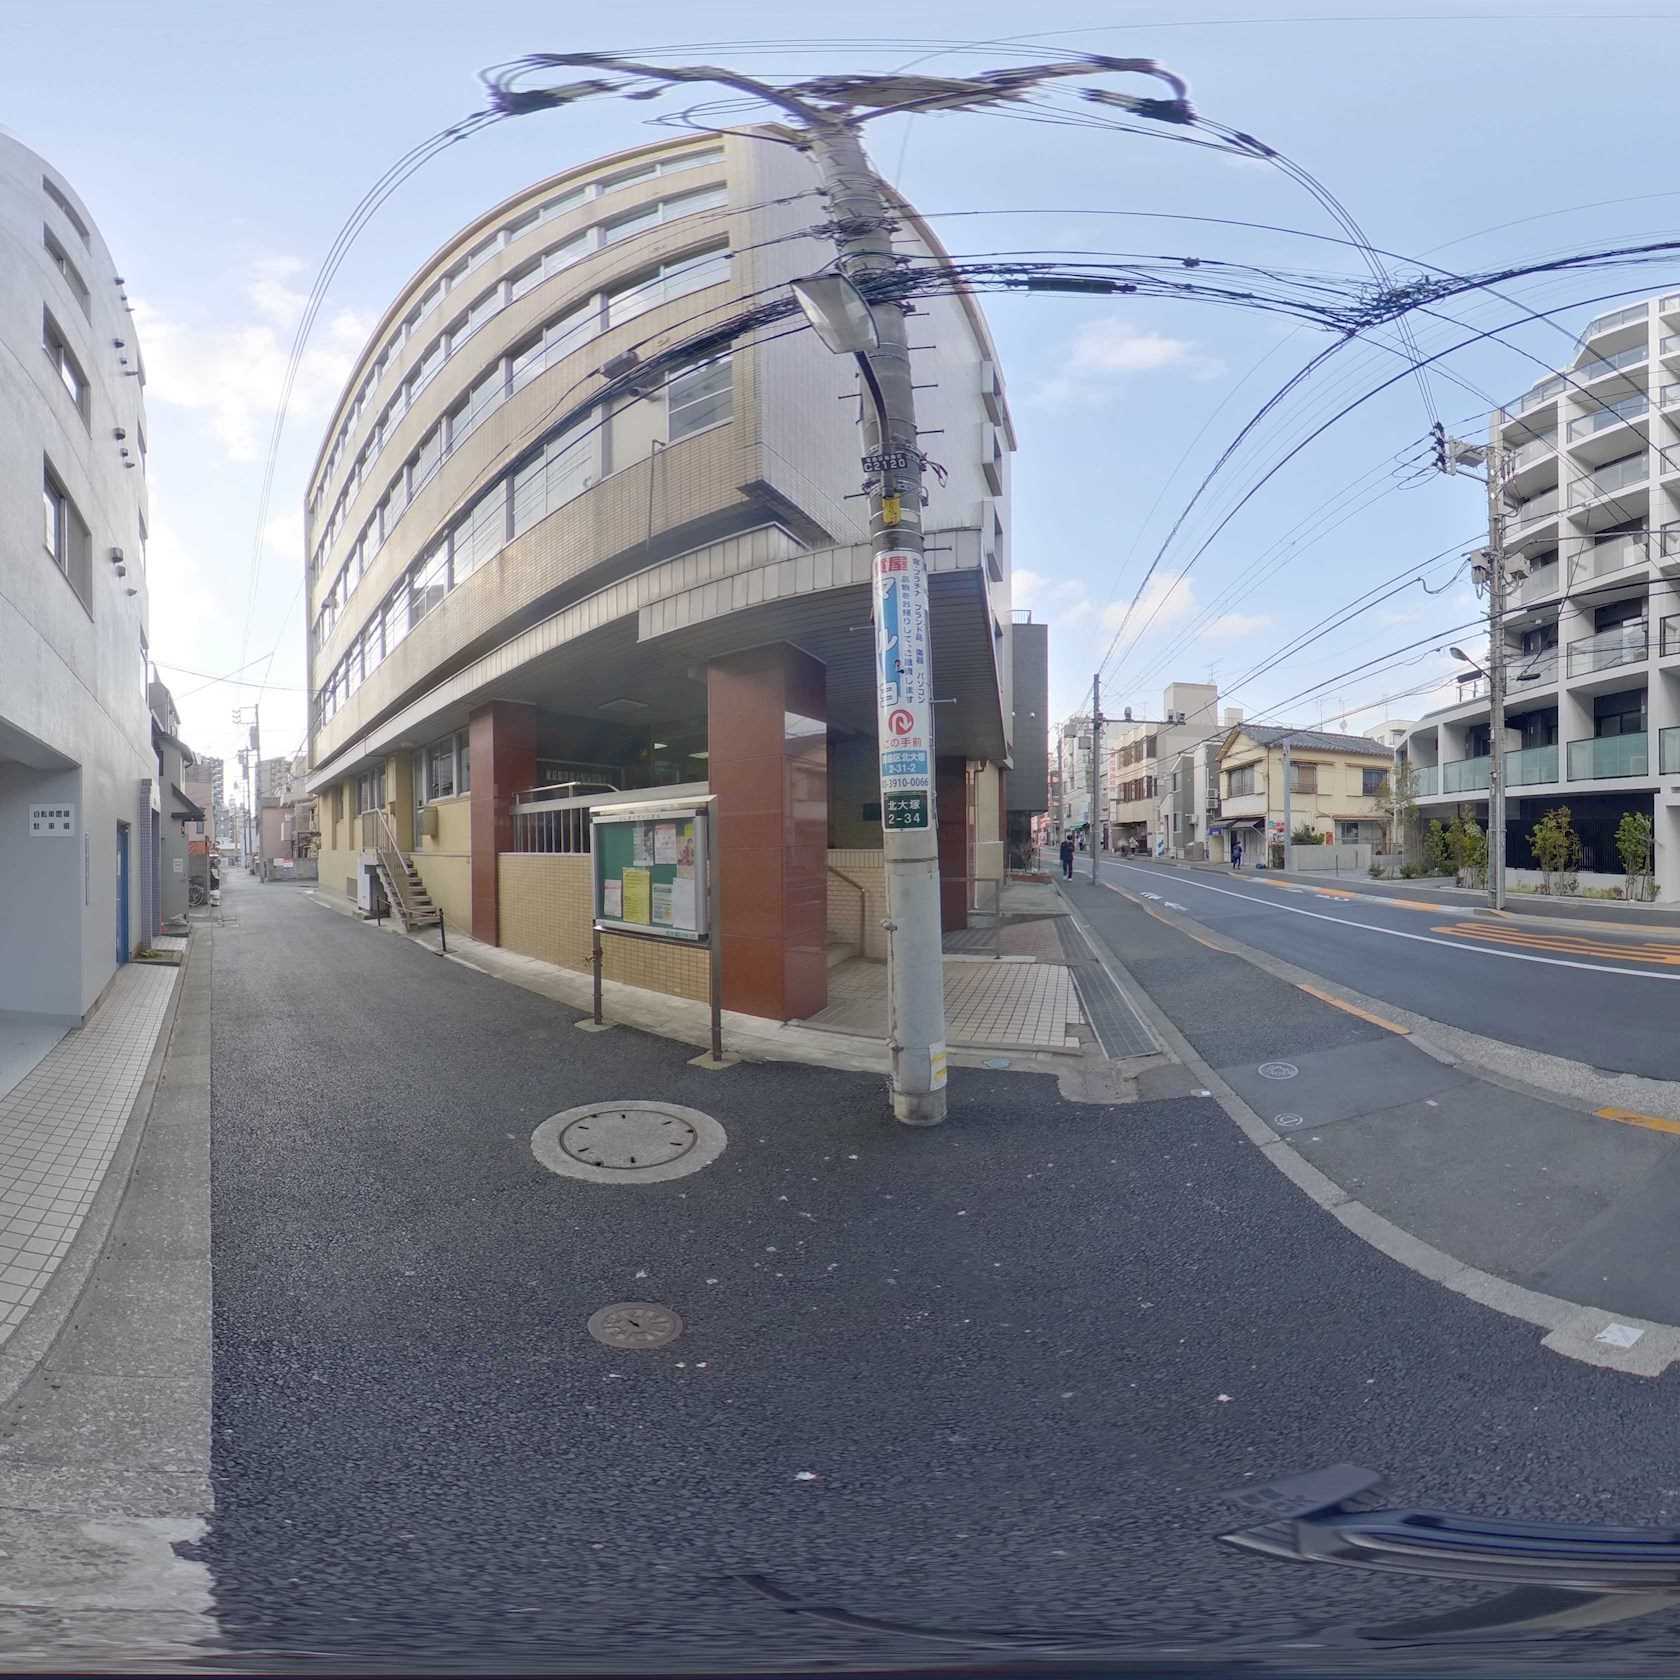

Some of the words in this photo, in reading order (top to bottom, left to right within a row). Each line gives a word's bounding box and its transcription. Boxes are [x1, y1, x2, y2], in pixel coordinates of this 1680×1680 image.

[864, 459, 906, 472] C2120
[888, 800, 921, 811] 北大塚
[888, 813, 921, 825] 2-34
